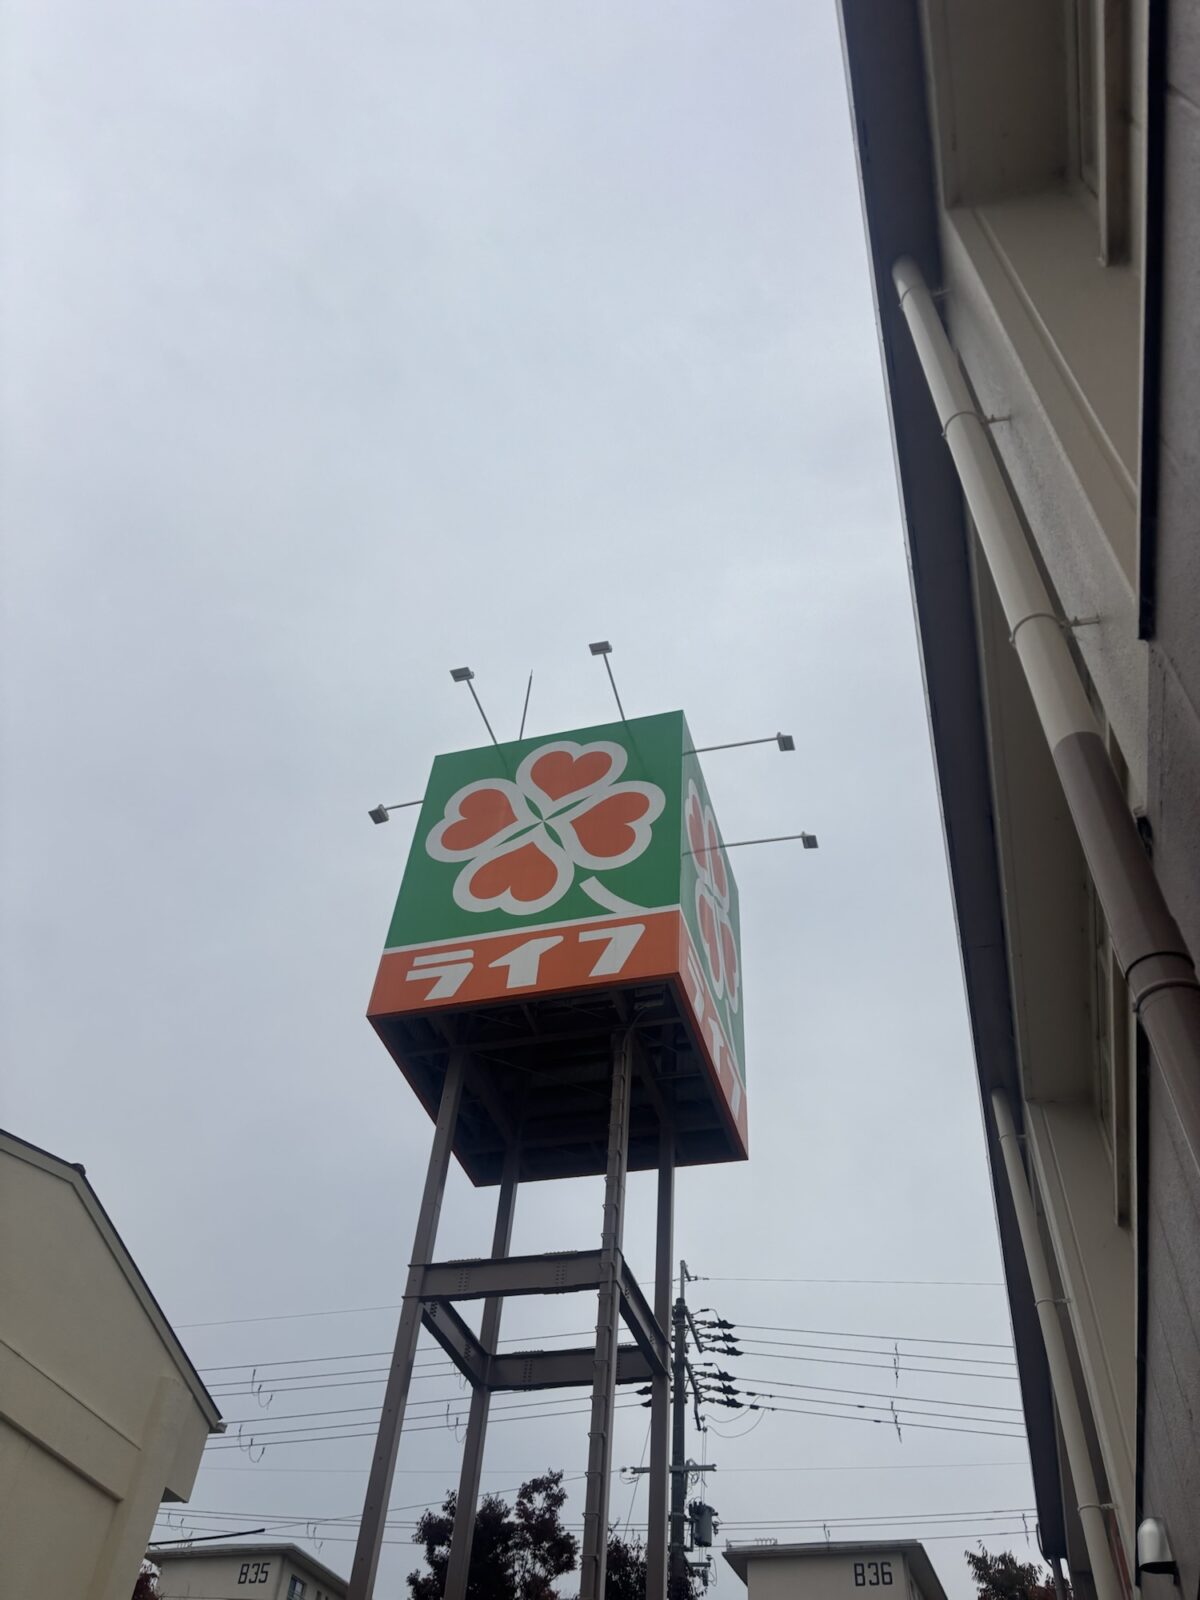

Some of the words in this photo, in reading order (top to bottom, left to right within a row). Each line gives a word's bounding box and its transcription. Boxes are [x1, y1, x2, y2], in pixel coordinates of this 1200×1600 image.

[405, 923, 646, 1001] ライフ
[687, 945, 742, 1120] ライフ
[853, 1562, 892, 1586] B36
